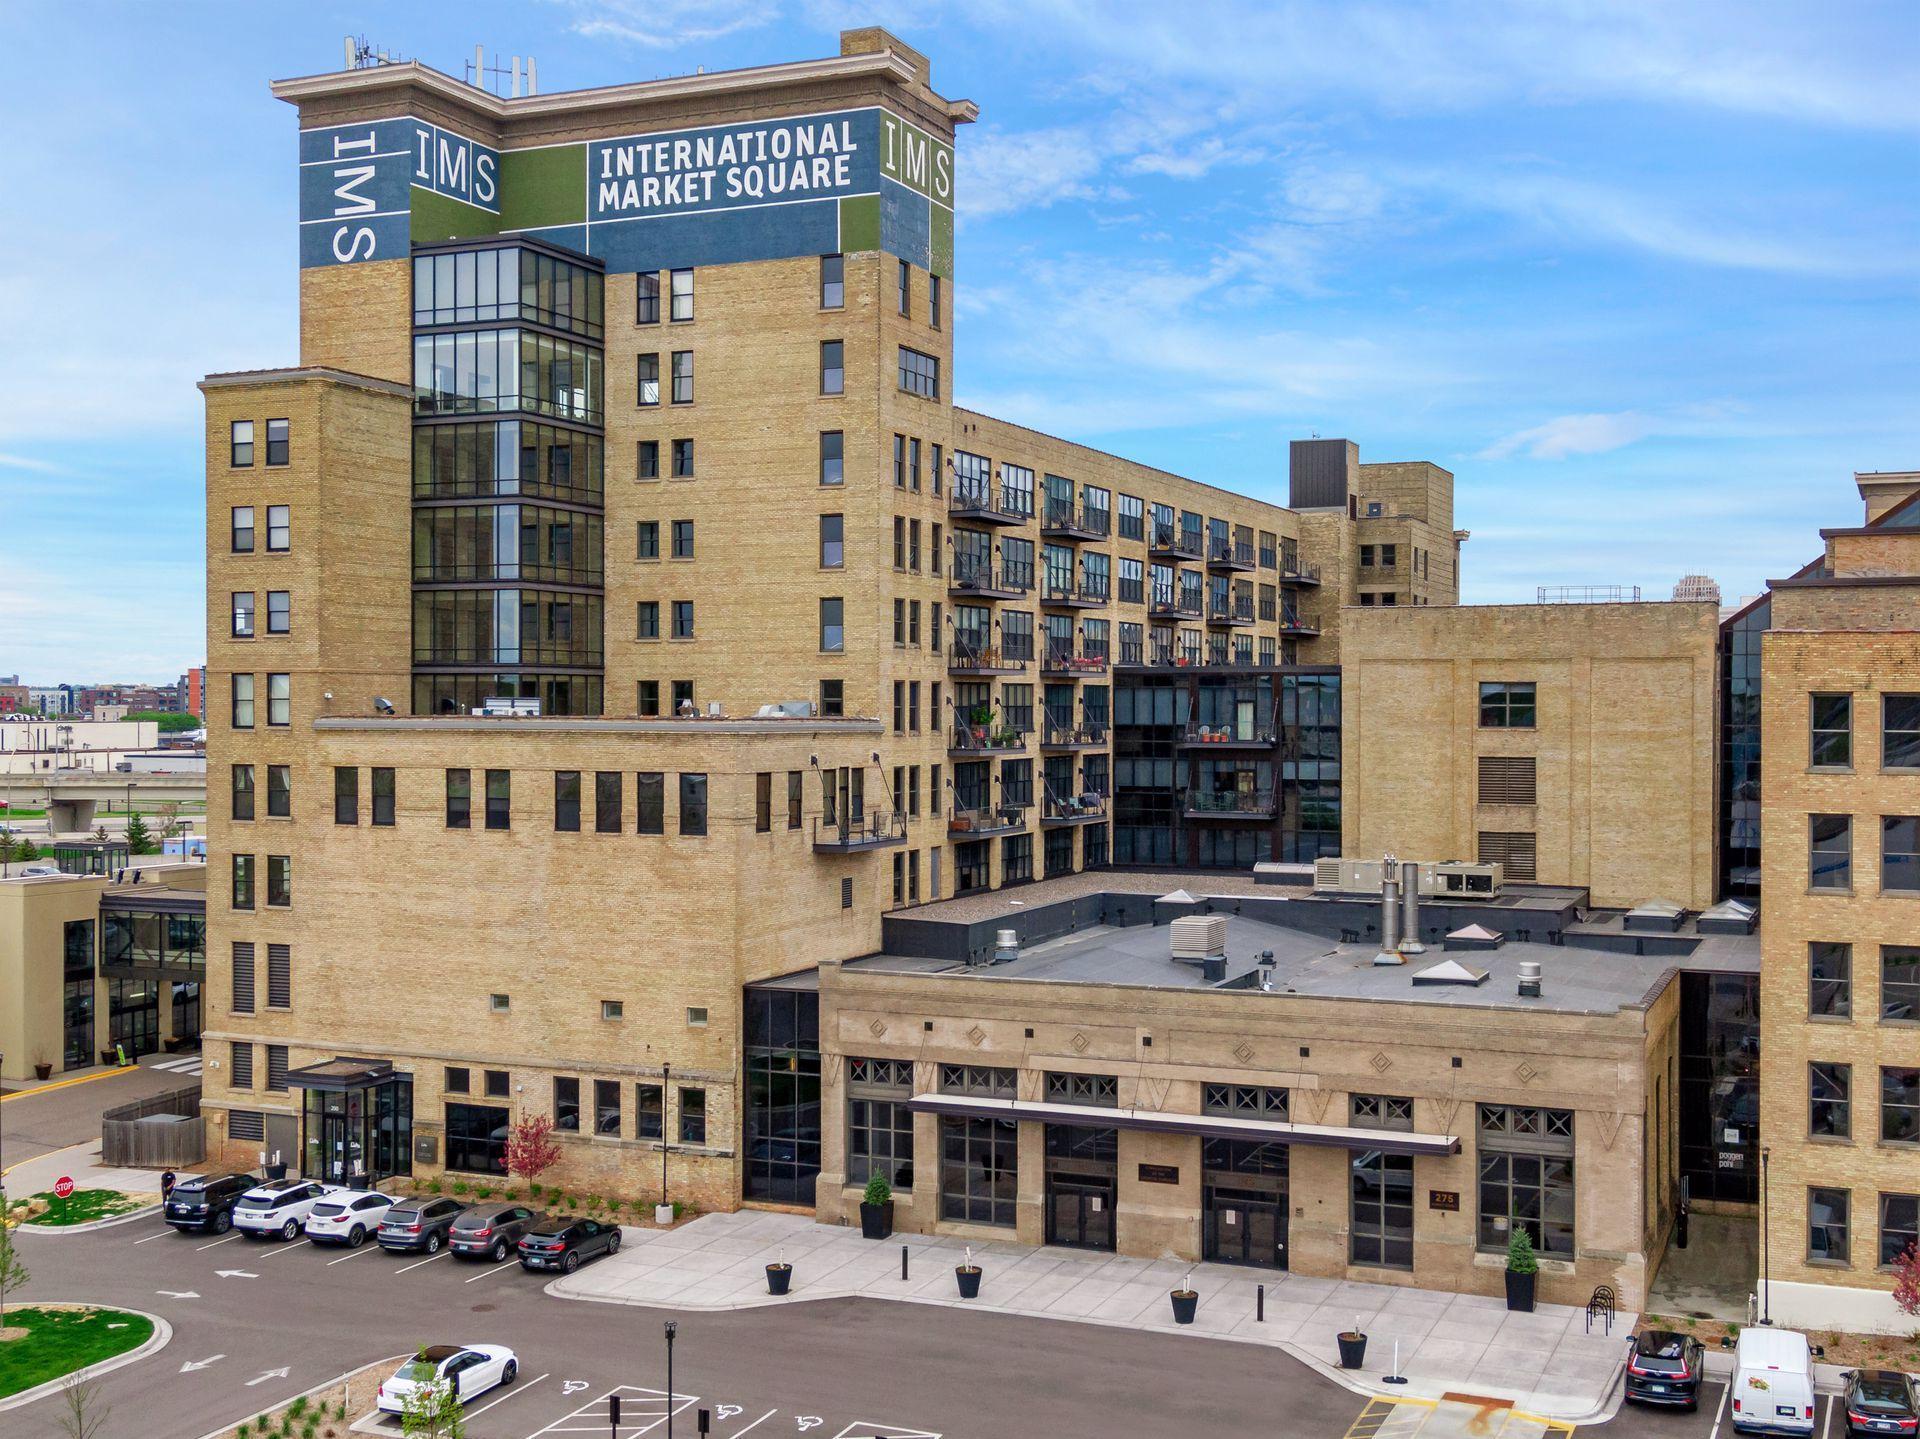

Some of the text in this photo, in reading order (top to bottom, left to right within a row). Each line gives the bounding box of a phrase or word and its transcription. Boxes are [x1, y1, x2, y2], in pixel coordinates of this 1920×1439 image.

[415, 128, 496, 202] IMS
[600, 120, 858, 179] INTERNATIONAL
[886, 119, 950, 198] IMS
[332, 130, 377, 263] IMS
[598, 154, 851, 212] MARKET SQUARE
[56, 1181, 73, 1193] STOP
[1435, 1193, 1454, 1204] 275
